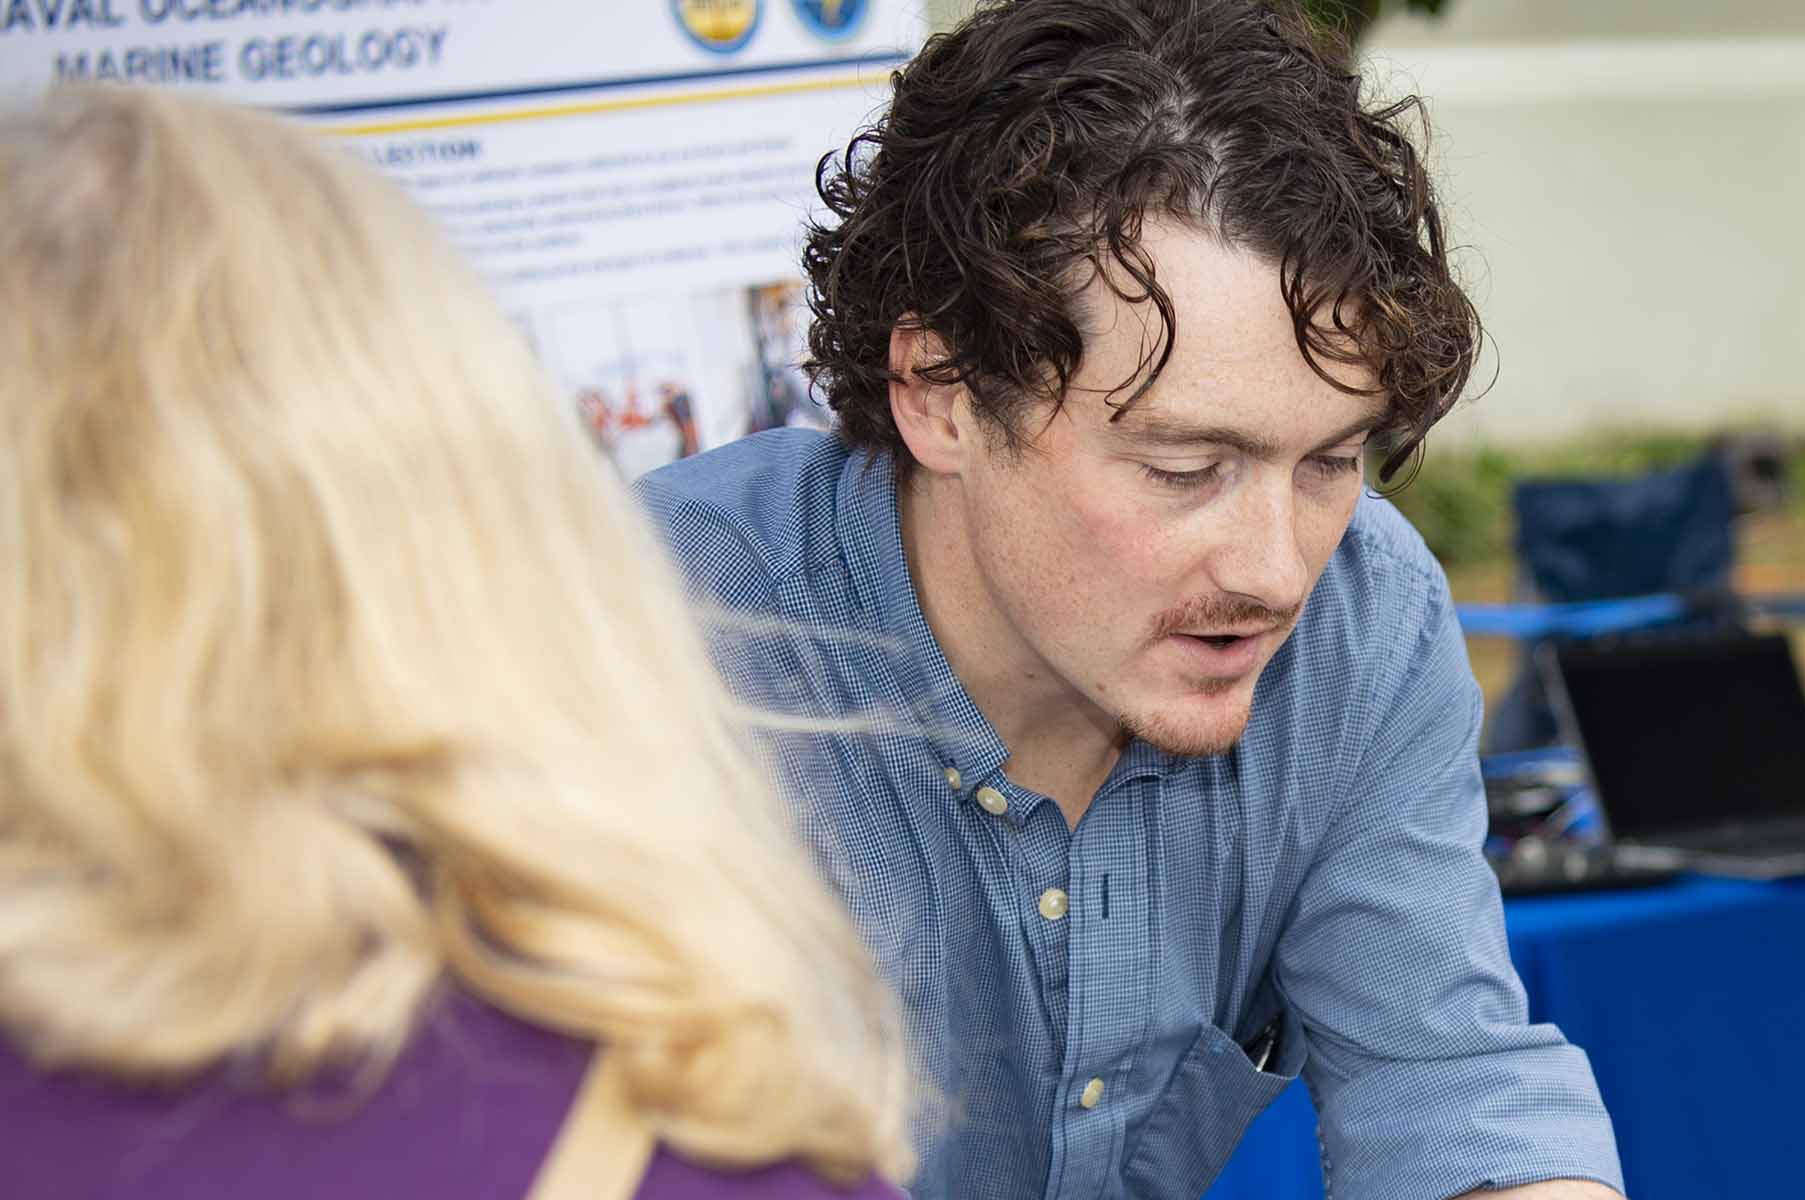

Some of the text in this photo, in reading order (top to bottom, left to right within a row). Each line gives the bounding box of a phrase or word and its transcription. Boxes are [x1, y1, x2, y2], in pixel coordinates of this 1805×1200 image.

[0, 0, 126, 34] AVAL
[54, 27, 448, 84] MARINE GEOLOGY
